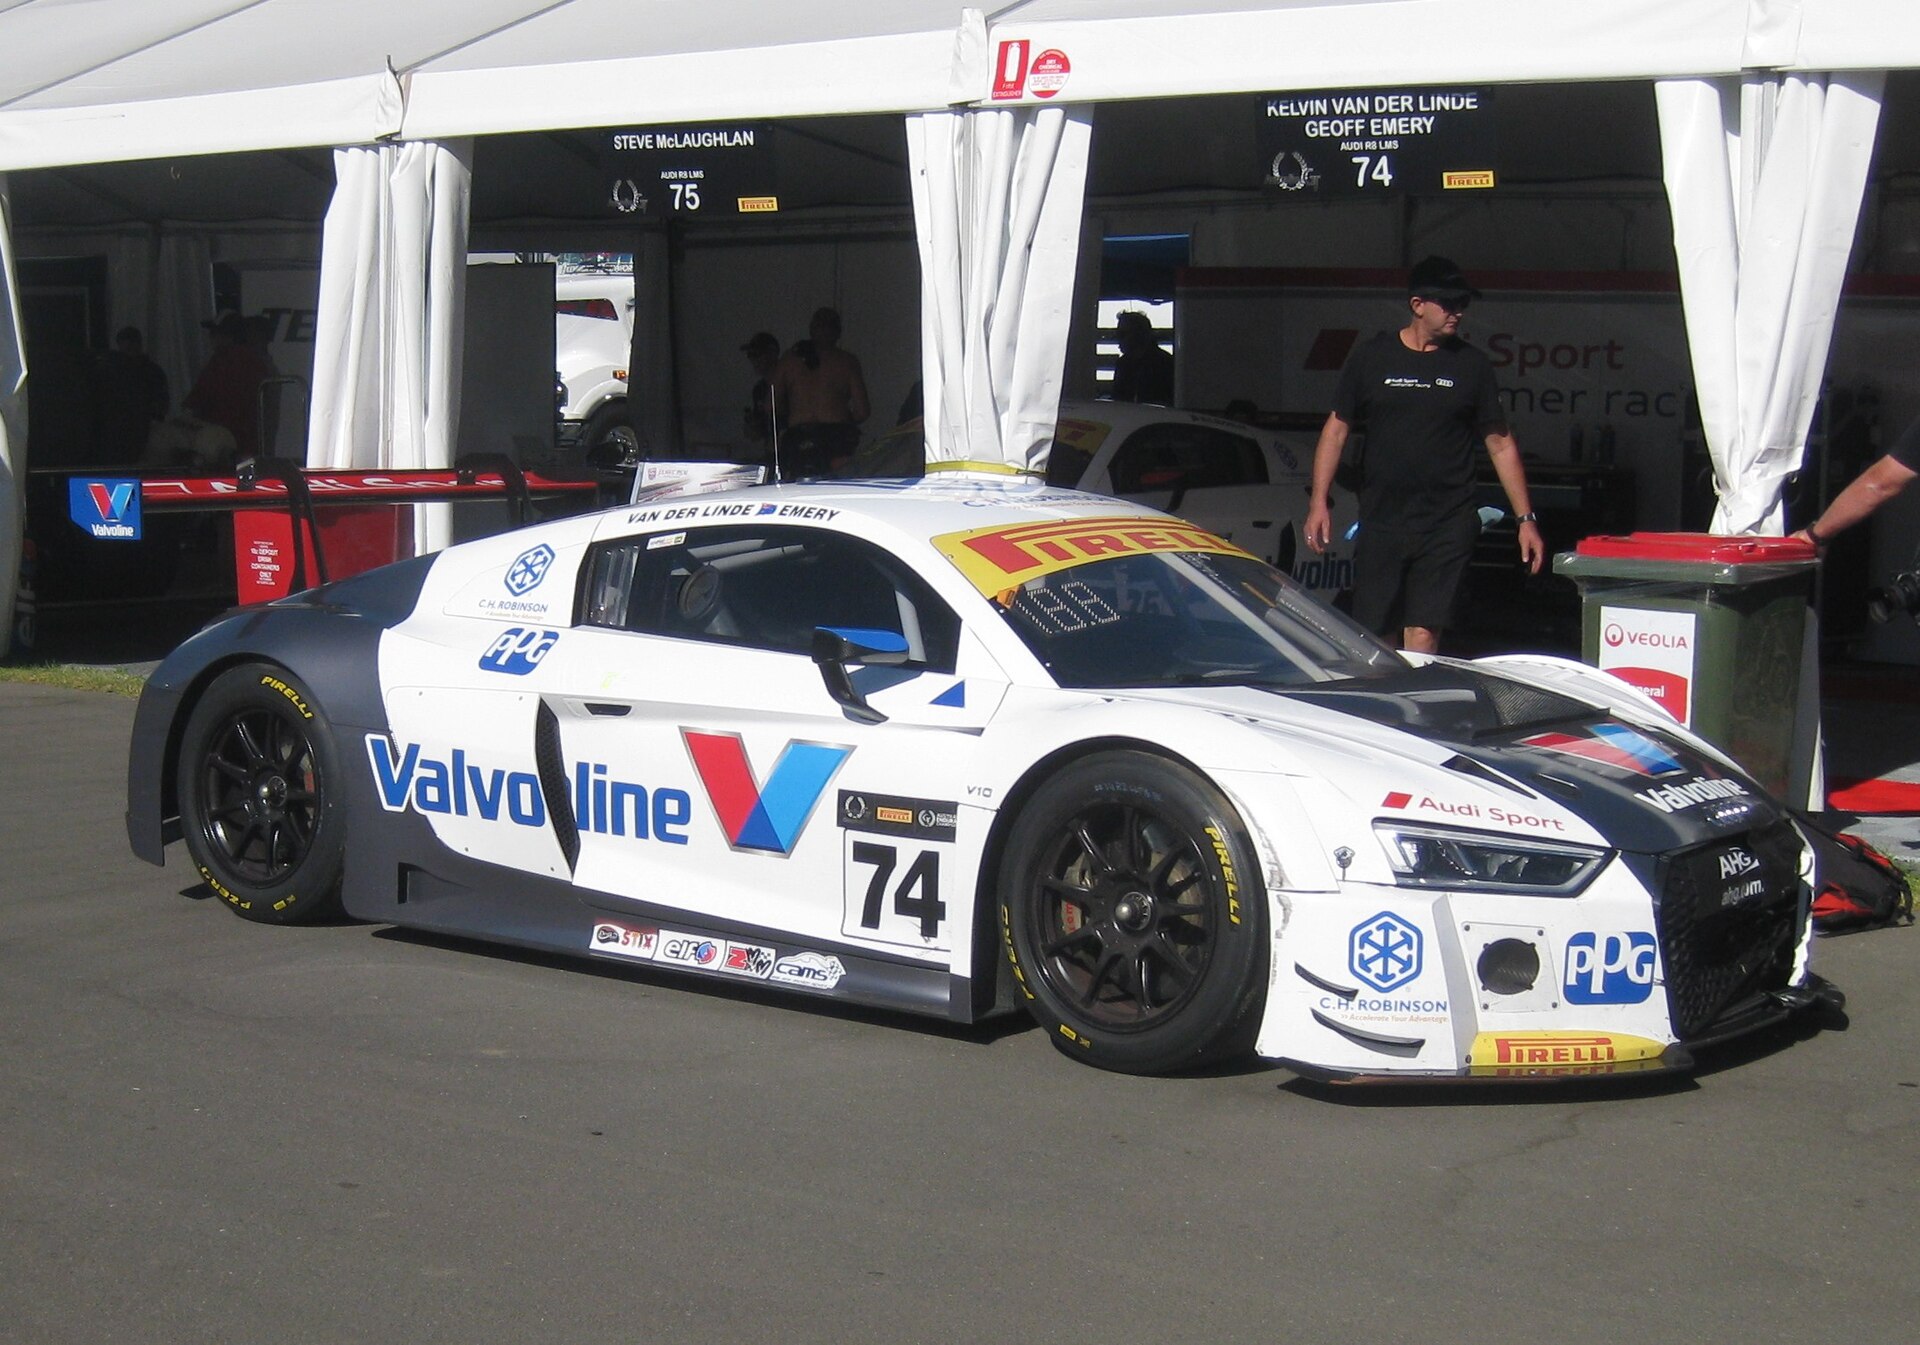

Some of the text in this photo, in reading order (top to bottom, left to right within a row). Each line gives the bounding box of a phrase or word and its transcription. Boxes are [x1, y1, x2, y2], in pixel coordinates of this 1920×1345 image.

[1267, 92, 1479, 117] KELVIN VAN DER LINDE
[613, 130, 755, 150] STEVE McLAUGHLAN
[1304, 116, 1436, 138] GEOFF EMERY
[1340, 140, 1399, 151] AUDI R8 LMS
[660, 171, 678, 179] AUDI
[688, 170, 705, 179] LMS
[1351, 155, 1393, 188] 74
[1447, 173, 1490, 187] PIRELLI
[669, 183, 700, 211] 75
[741, 199, 775, 210] PIRELLI
[1487, 332, 1625, 377] Sport
[1605, 388, 1679, 418] rac
[626, 503, 842, 524] VAN DER LINDE EMERY
[91, 523, 134, 537] Valvoline
[961, 517, 1248, 575] PIRELL
[498, 600, 549, 614] ROBINSON
[483, 627, 556, 666] PPG
[1627, 631, 1688, 650] VEOLIA
[261, 675, 315, 720] PIRELLI
[369, 737, 691, 846] Valvoline
[1634, 776, 1750, 814] Valvoline
[1419, 796, 1566, 832] Audi Sport
[1204, 826, 1241, 925] PIRELLI
[1719, 850, 1752, 880] AHG
[852, 840, 946, 938] 74
[663, 939, 701, 962] elf
[1566, 931, 1655, 995] PPG
[776, 962, 829, 981] cams
[1319, 997, 1448, 1013] C.H. ROBINSON
[1494, 1037, 1615, 1064] PIRELLI
